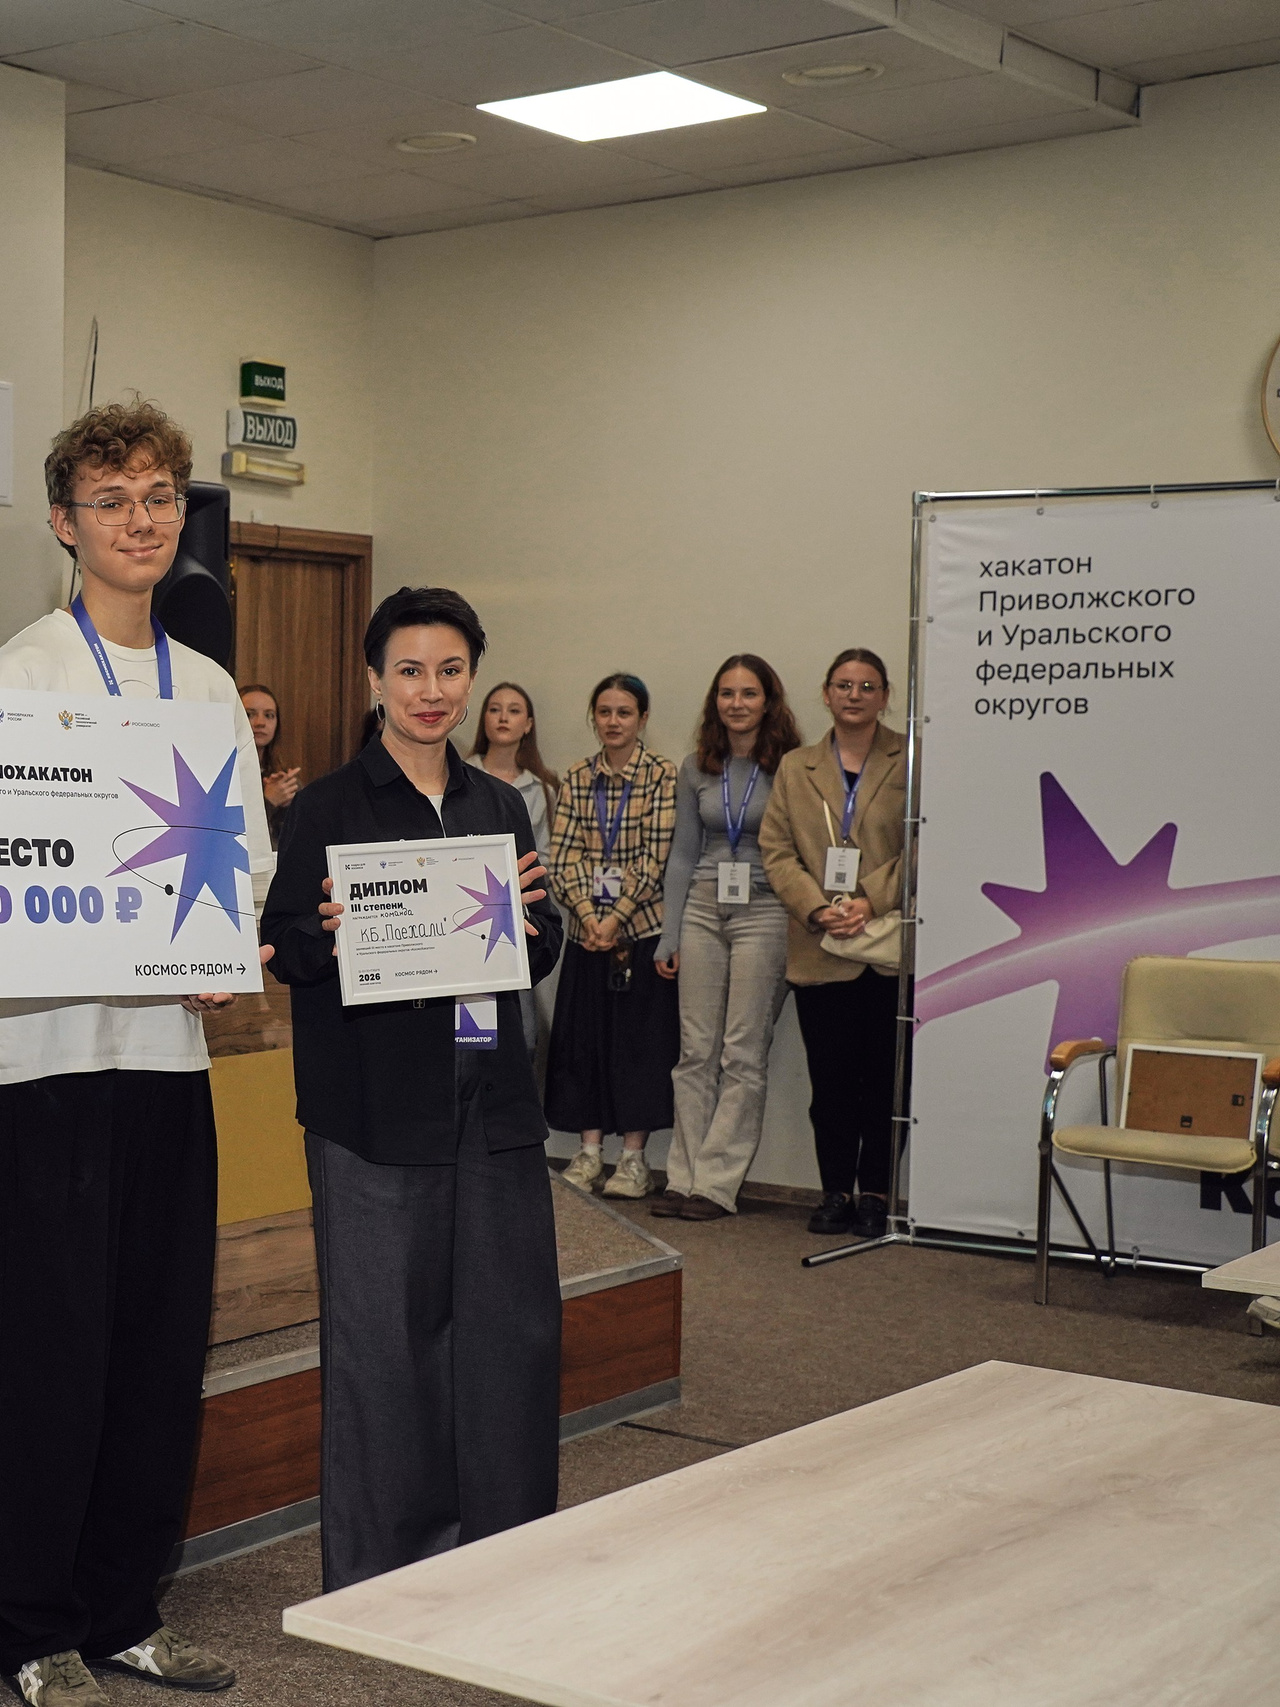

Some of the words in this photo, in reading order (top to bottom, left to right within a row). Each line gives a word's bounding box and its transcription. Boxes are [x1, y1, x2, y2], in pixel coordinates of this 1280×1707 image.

[254, 374, 284, 390] ВЫХОД
[246, 415, 294, 447] ВЫХОД
[979, 556, 1093, 578] хакатон
[978, 587, 1195, 616] Приволжского
[977, 630, 993, 646] и
[1001, 624, 1171, 651] Уральского
[975, 659, 1175, 686] федеральных
[974, 696, 1089, 720] округов
[13, 788, 50, 797] Уральского
[50, 790, 92, 799] федеральных
[349, 878, 428, 901] ДИПЛОМ
[24, 884, 104, 924] 000
[363, 902, 403, 912] степени
[380, 907, 414, 918] команда
[135, 963, 187, 976] КОСМОС
[191, 963, 233, 976] РЯДОМ
[358, 973, 381, 982] 2026
